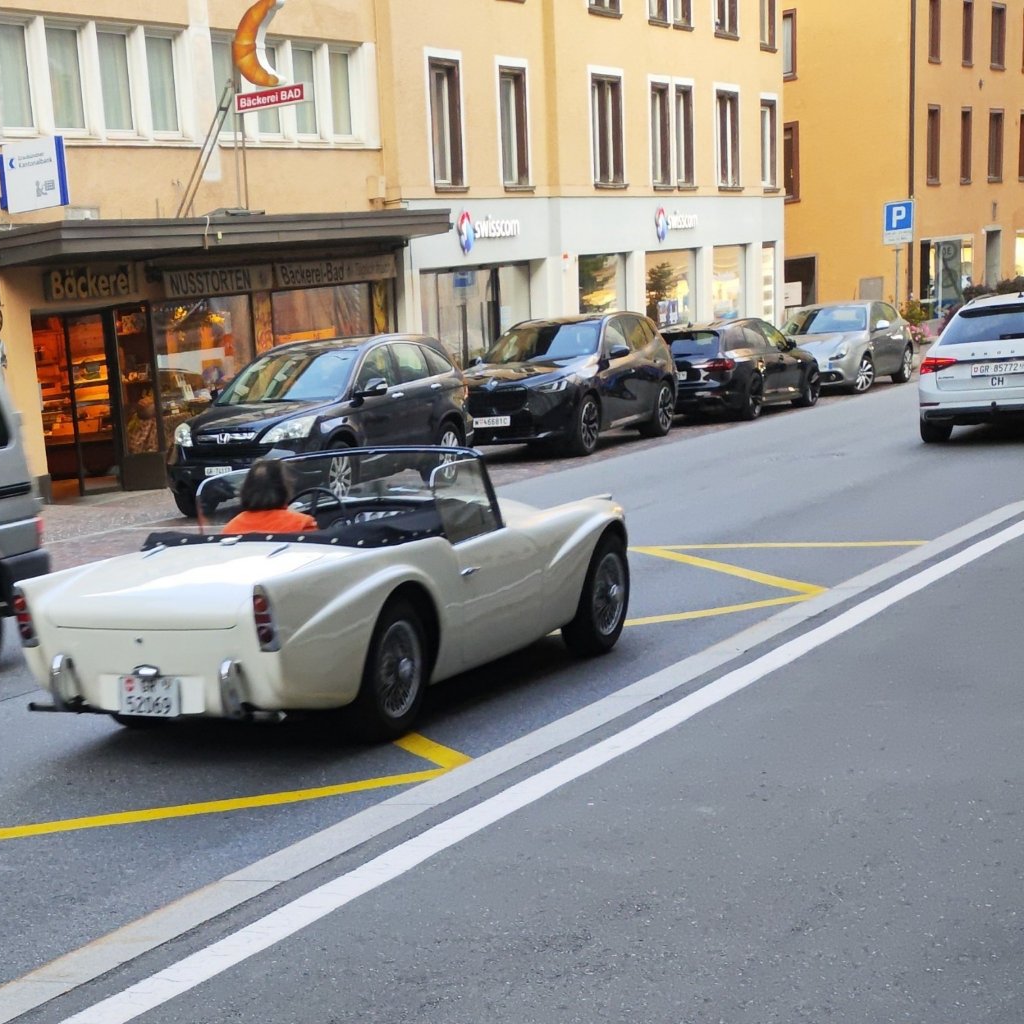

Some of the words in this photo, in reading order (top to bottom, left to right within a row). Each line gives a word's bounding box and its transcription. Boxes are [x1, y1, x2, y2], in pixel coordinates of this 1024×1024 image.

[239, 92, 279, 108] Bäckerei
[280, 88, 301, 101] BAD
[475, 214, 520, 239] swisscom
[667, 211, 698, 230] swisscom
[892, 205, 906, 229] P
[169, 268, 253, 296] NUSSTORTEN
[991, 376, 1004, 387] CH
